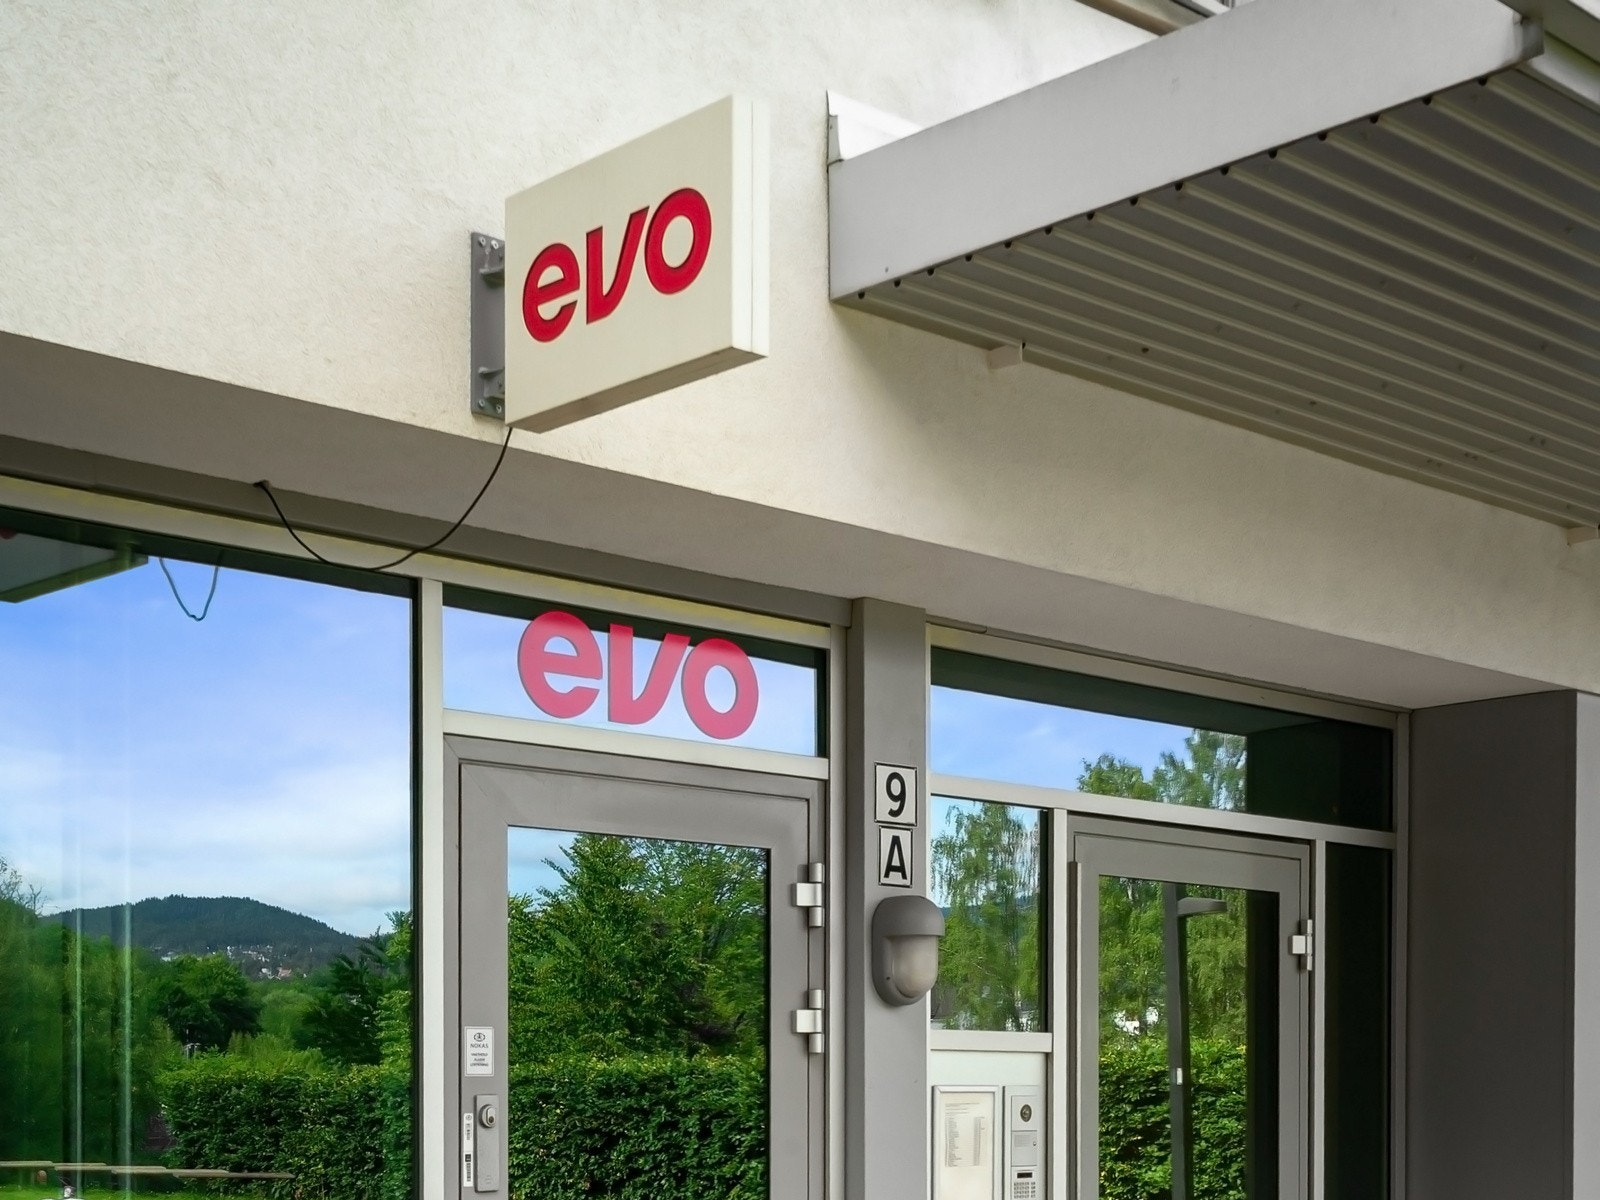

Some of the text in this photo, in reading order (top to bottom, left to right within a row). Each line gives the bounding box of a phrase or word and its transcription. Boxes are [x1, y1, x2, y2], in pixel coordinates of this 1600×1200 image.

[522, 187, 712, 343] evo
[517, 610, 759, 740] evo
[886, 772, 906, 818] 9
[884, 835, 907, 880] A
